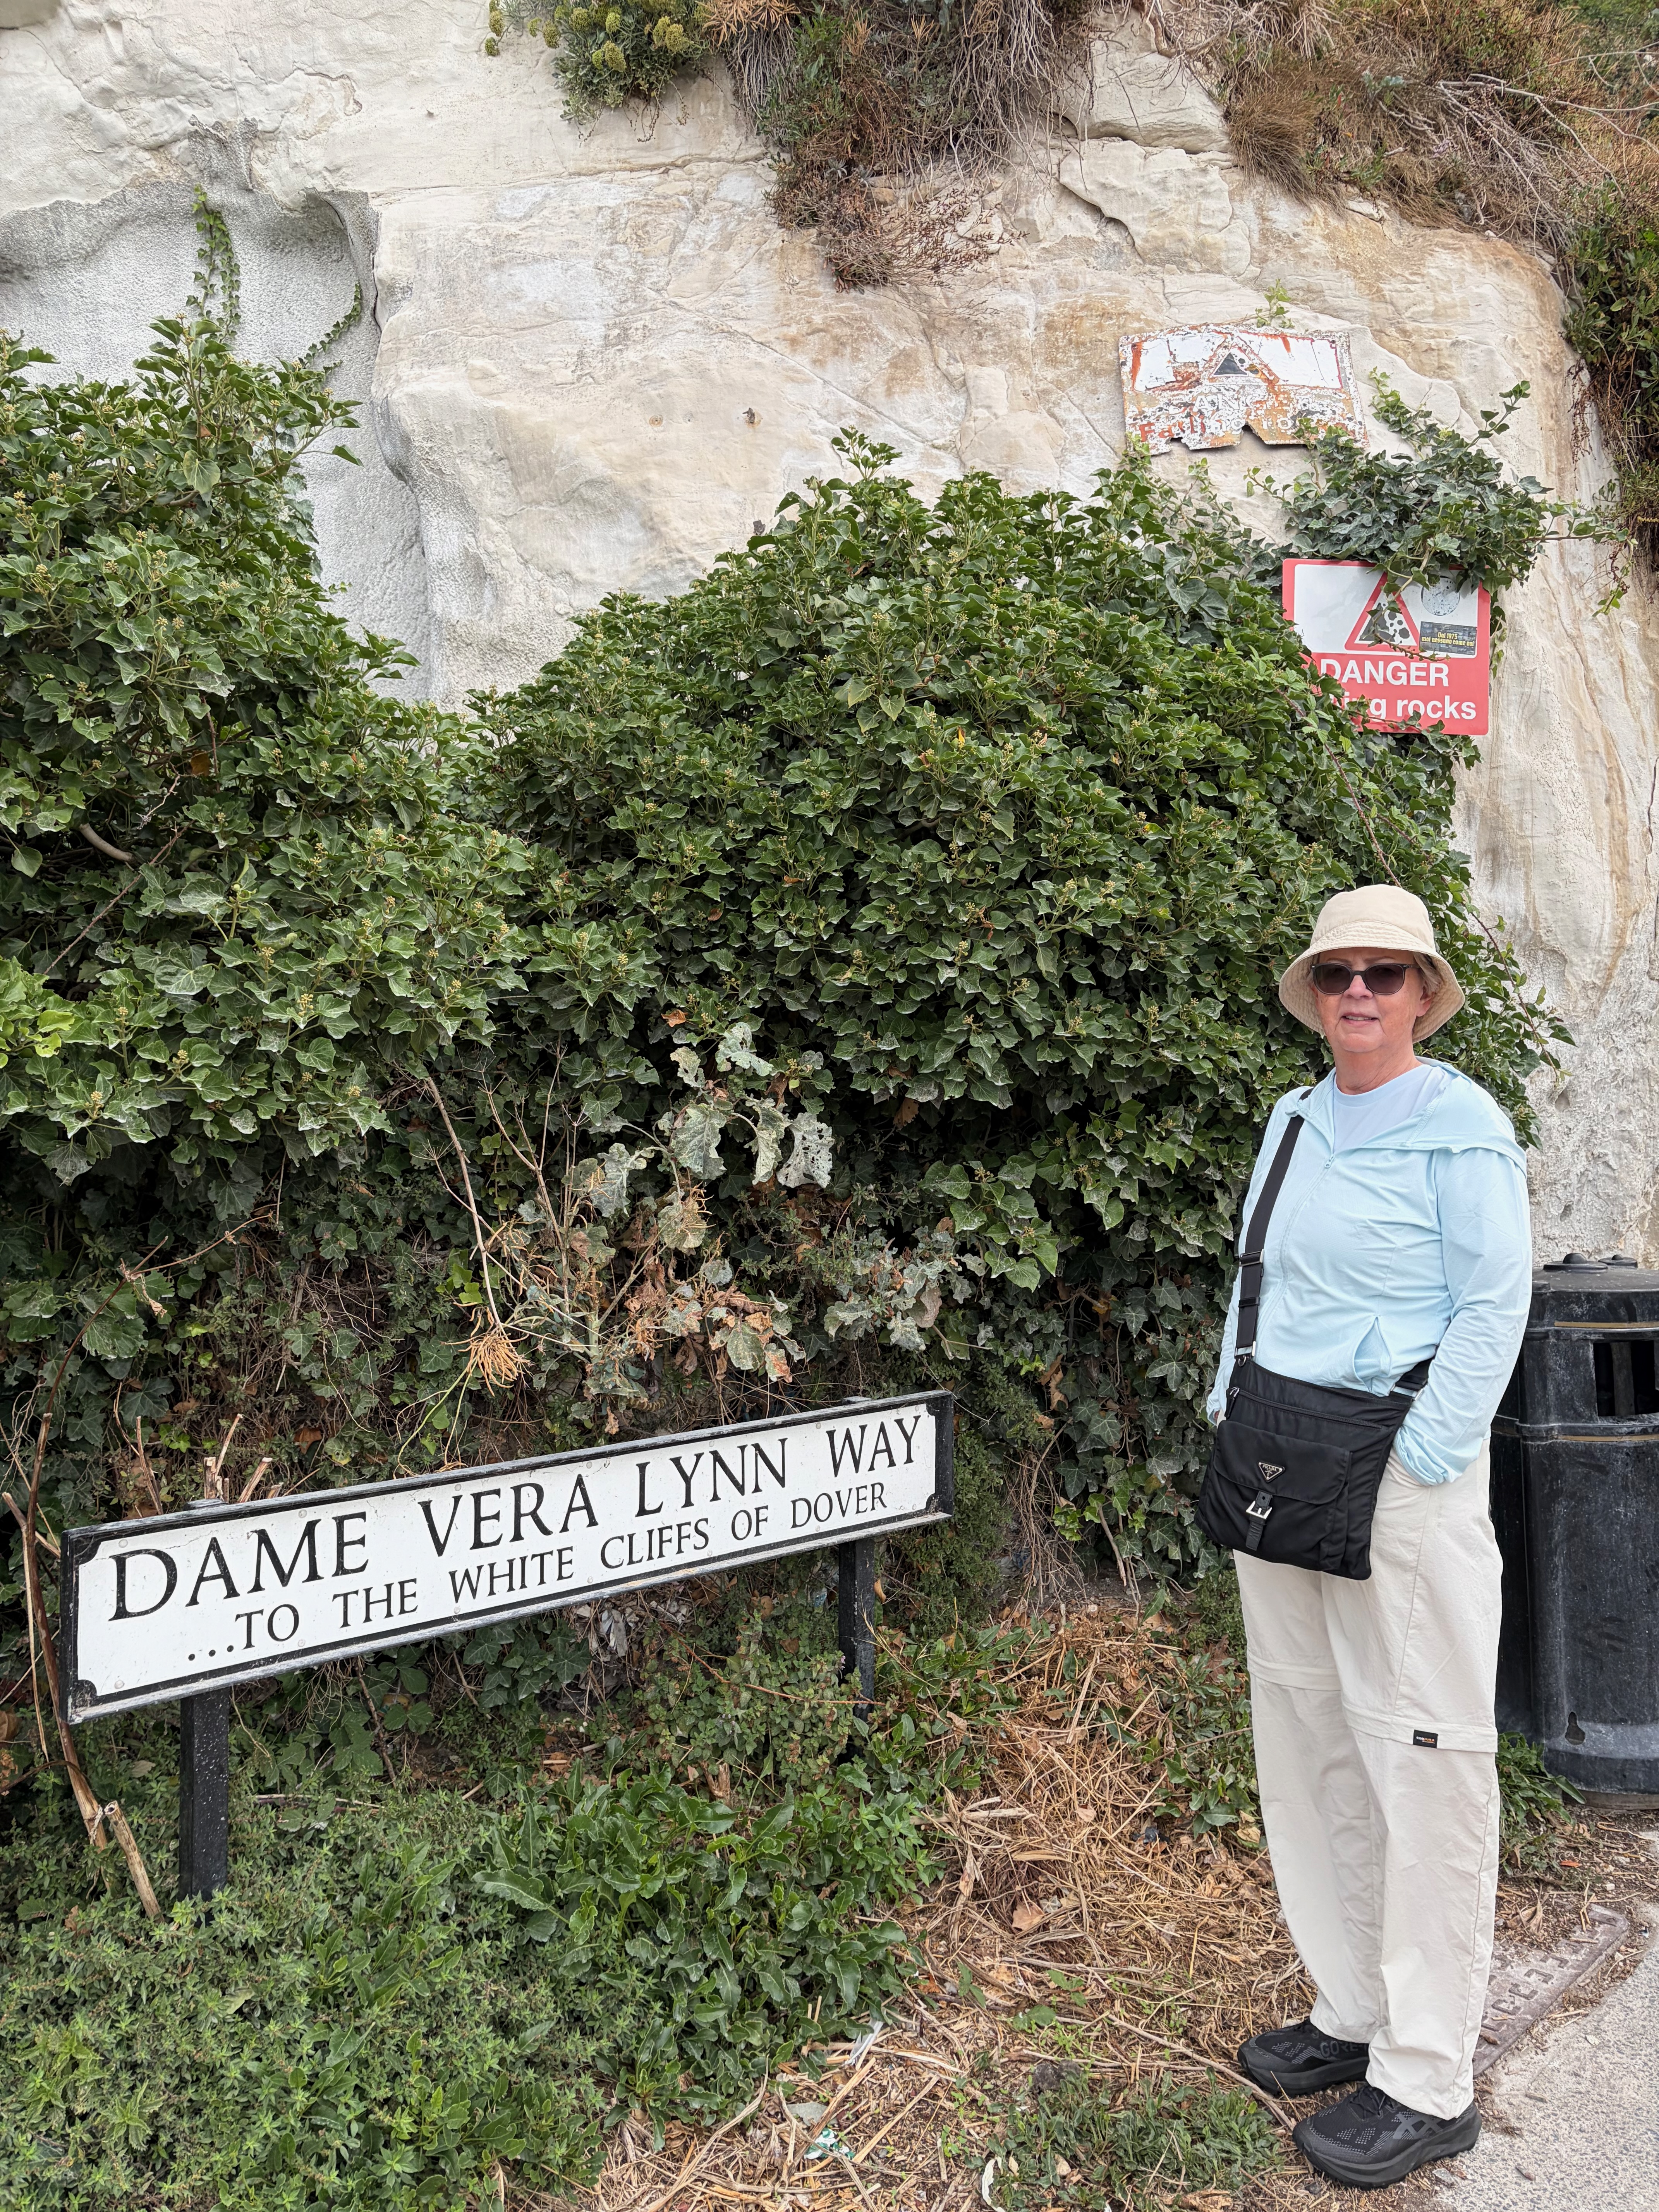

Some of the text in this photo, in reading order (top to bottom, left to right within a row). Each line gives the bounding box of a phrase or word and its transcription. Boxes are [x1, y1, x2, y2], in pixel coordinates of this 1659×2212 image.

[1321, 658, 1449, 687] DANGER
[1397, 695, 1476, 720] rocks
[109, 1415, 921, 1621] DAME VERA LYNN WAY
[333, 1578, 418, 1628] THE
[449, 1546, 574, 1603] WHITE
[601, 1518, 709, 1569] CLIFFS
[732, 1505, 768, 1540] OF
[791, 1482, 887, 1528] DOVER
